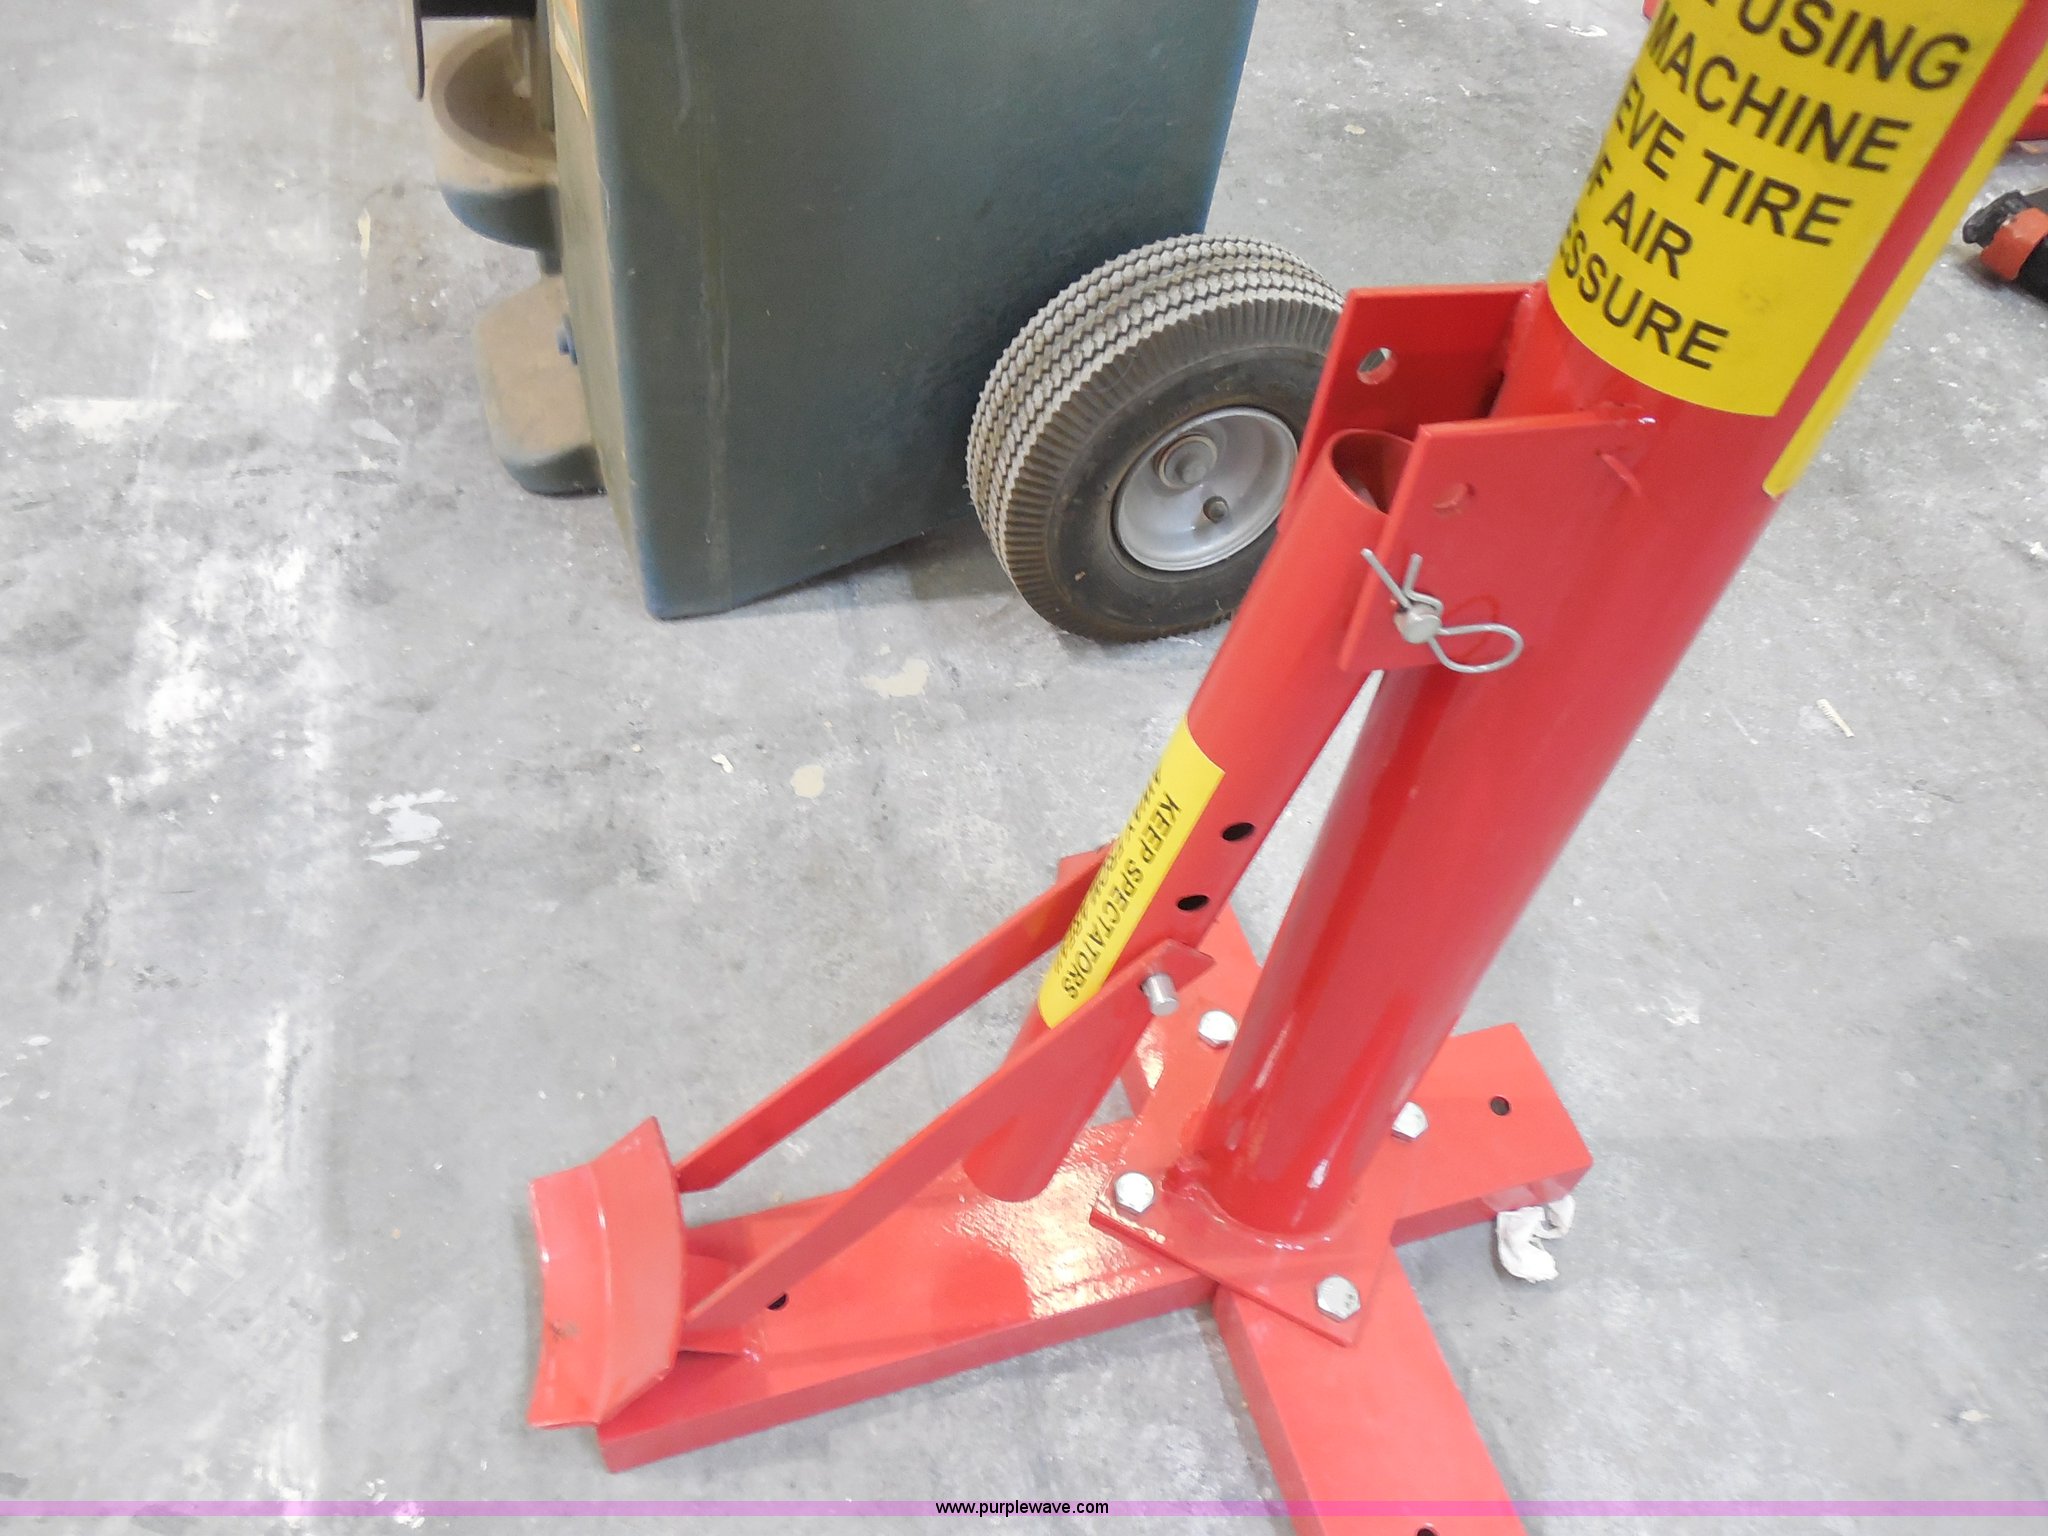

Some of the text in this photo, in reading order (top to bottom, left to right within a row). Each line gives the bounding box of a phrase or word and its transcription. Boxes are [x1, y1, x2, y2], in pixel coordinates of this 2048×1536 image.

[1647, 2, 1912, 173] MACHINE
[1736, 0, 1971, 91] USING
[1603, 190, 1693, 280] AIR
[1695, 148, 1854, 247] TIRE
[1061, 792, 1181, 999] KEEP SPECTATORS
